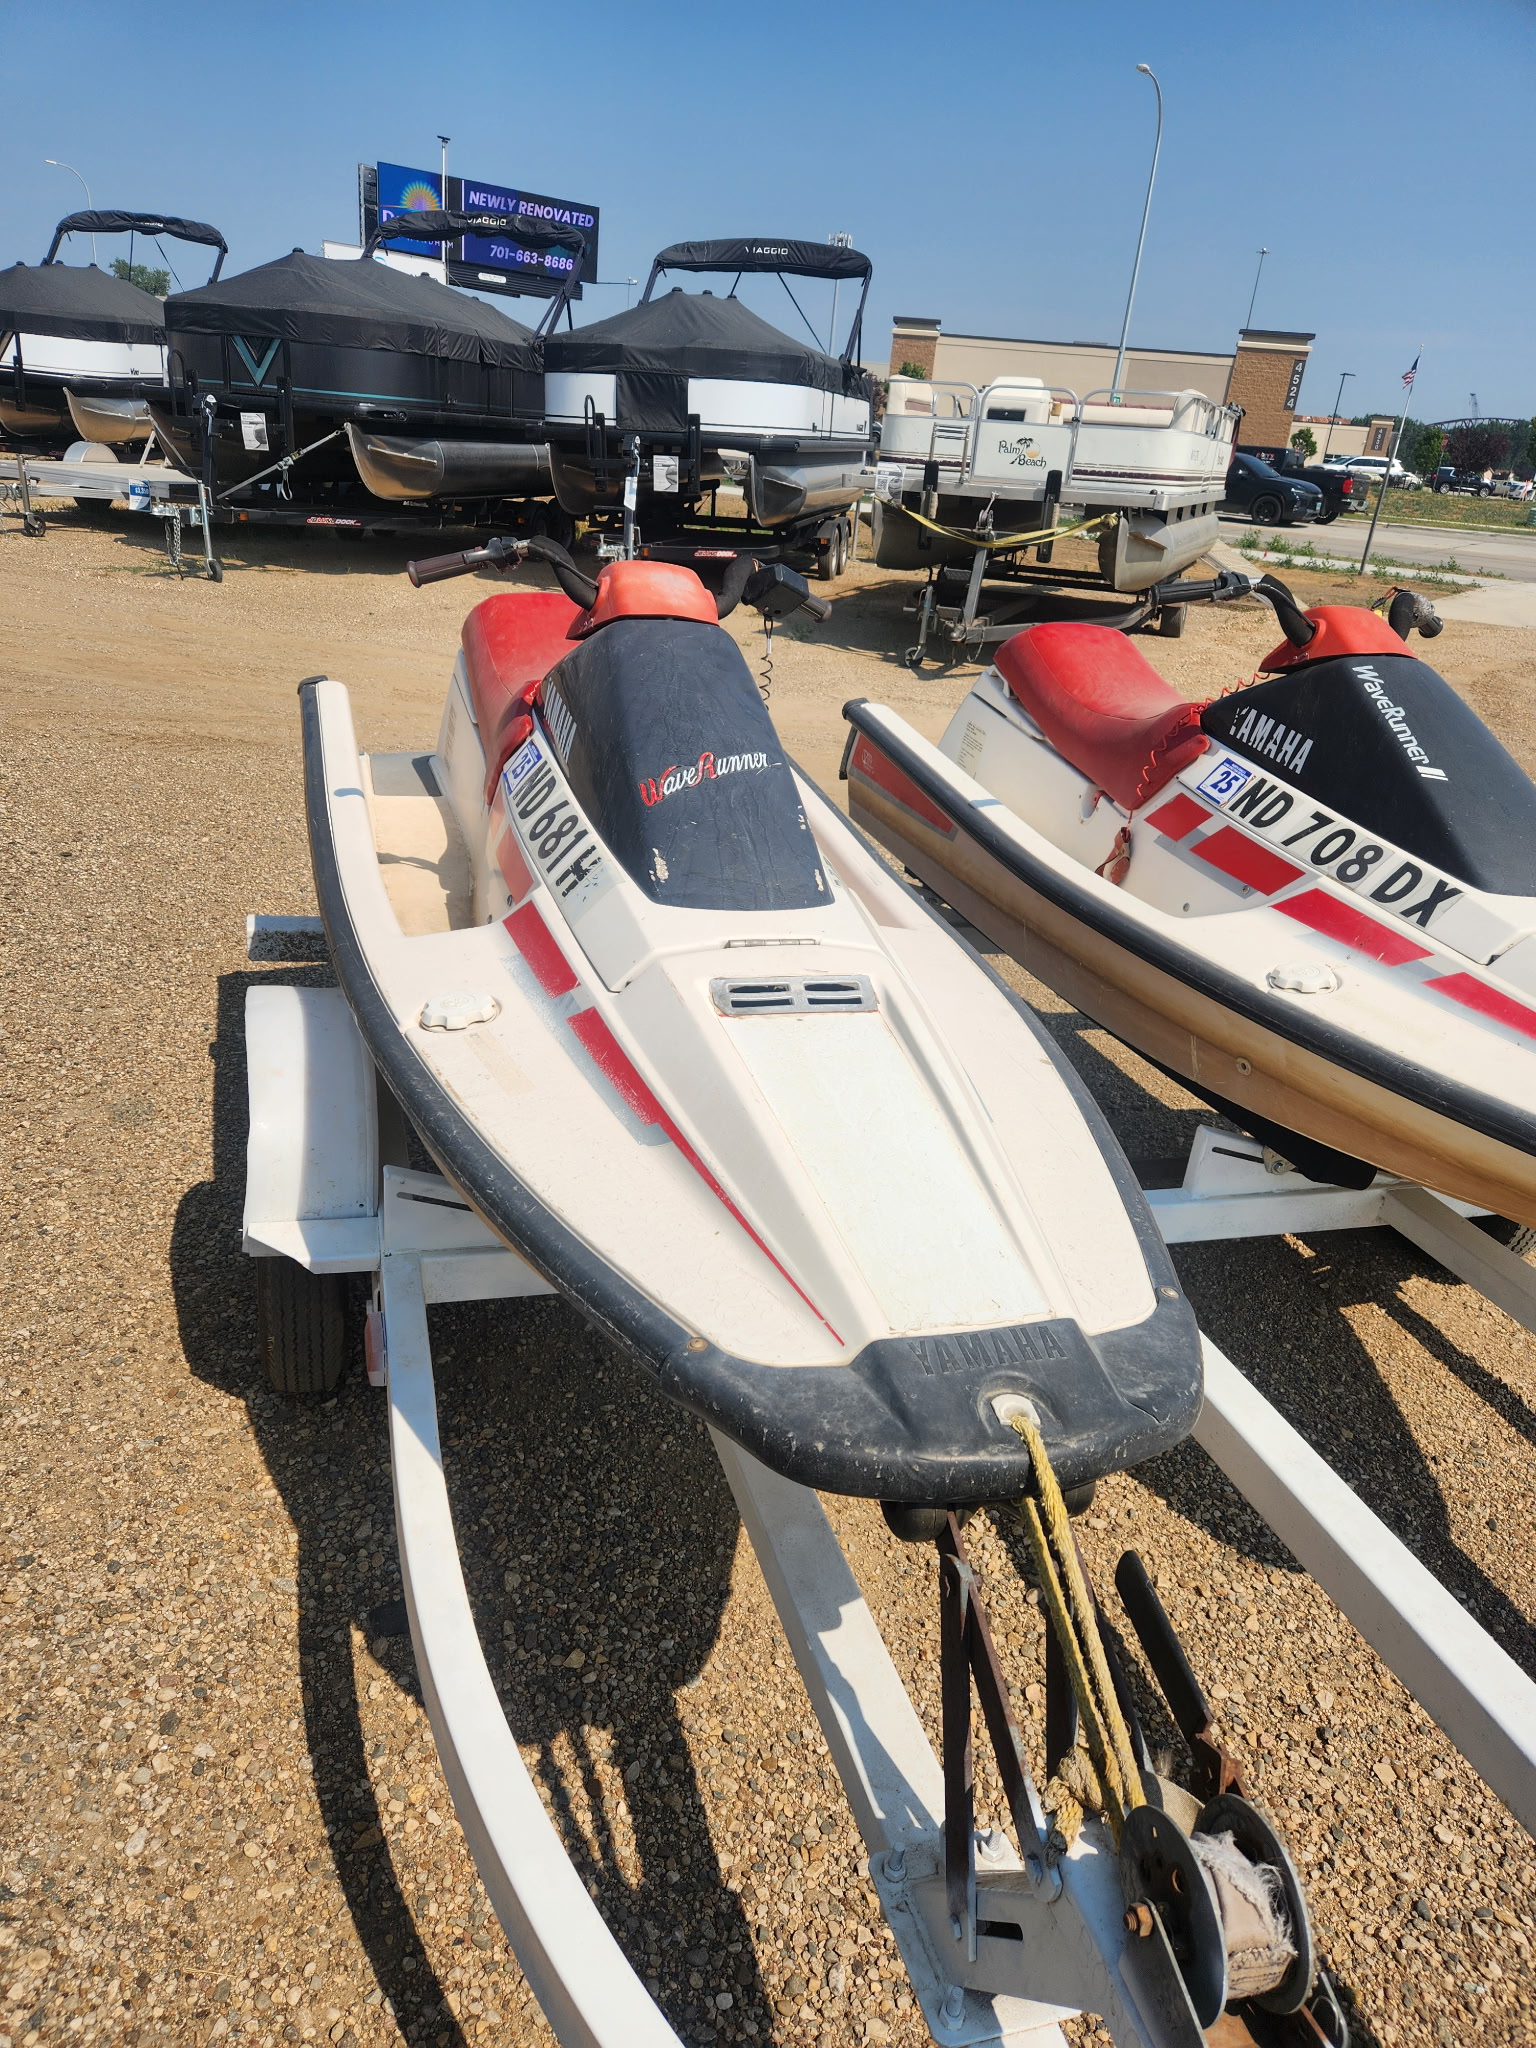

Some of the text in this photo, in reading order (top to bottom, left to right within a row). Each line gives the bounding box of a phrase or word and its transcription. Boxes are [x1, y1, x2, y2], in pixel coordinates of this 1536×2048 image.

[469, 190, 595, 228] NEWLY RENOVATED
[489, 245, 574, 271] 701-663-8686
[1286, 362, 1303, 408] 4524
[998, 440, 1021, 454] Palm
[1018, 453, 1047, 469] Beach
[1352, 665, 1430, 764] WaveRunner
[639, 752, 769, 806] WaveRunner
[1210, 770, 1241, 794] 25
[1229, 777, 1464, 928] ND 708 DX
[906, 1325, 1068, 1376] YAMAHA
